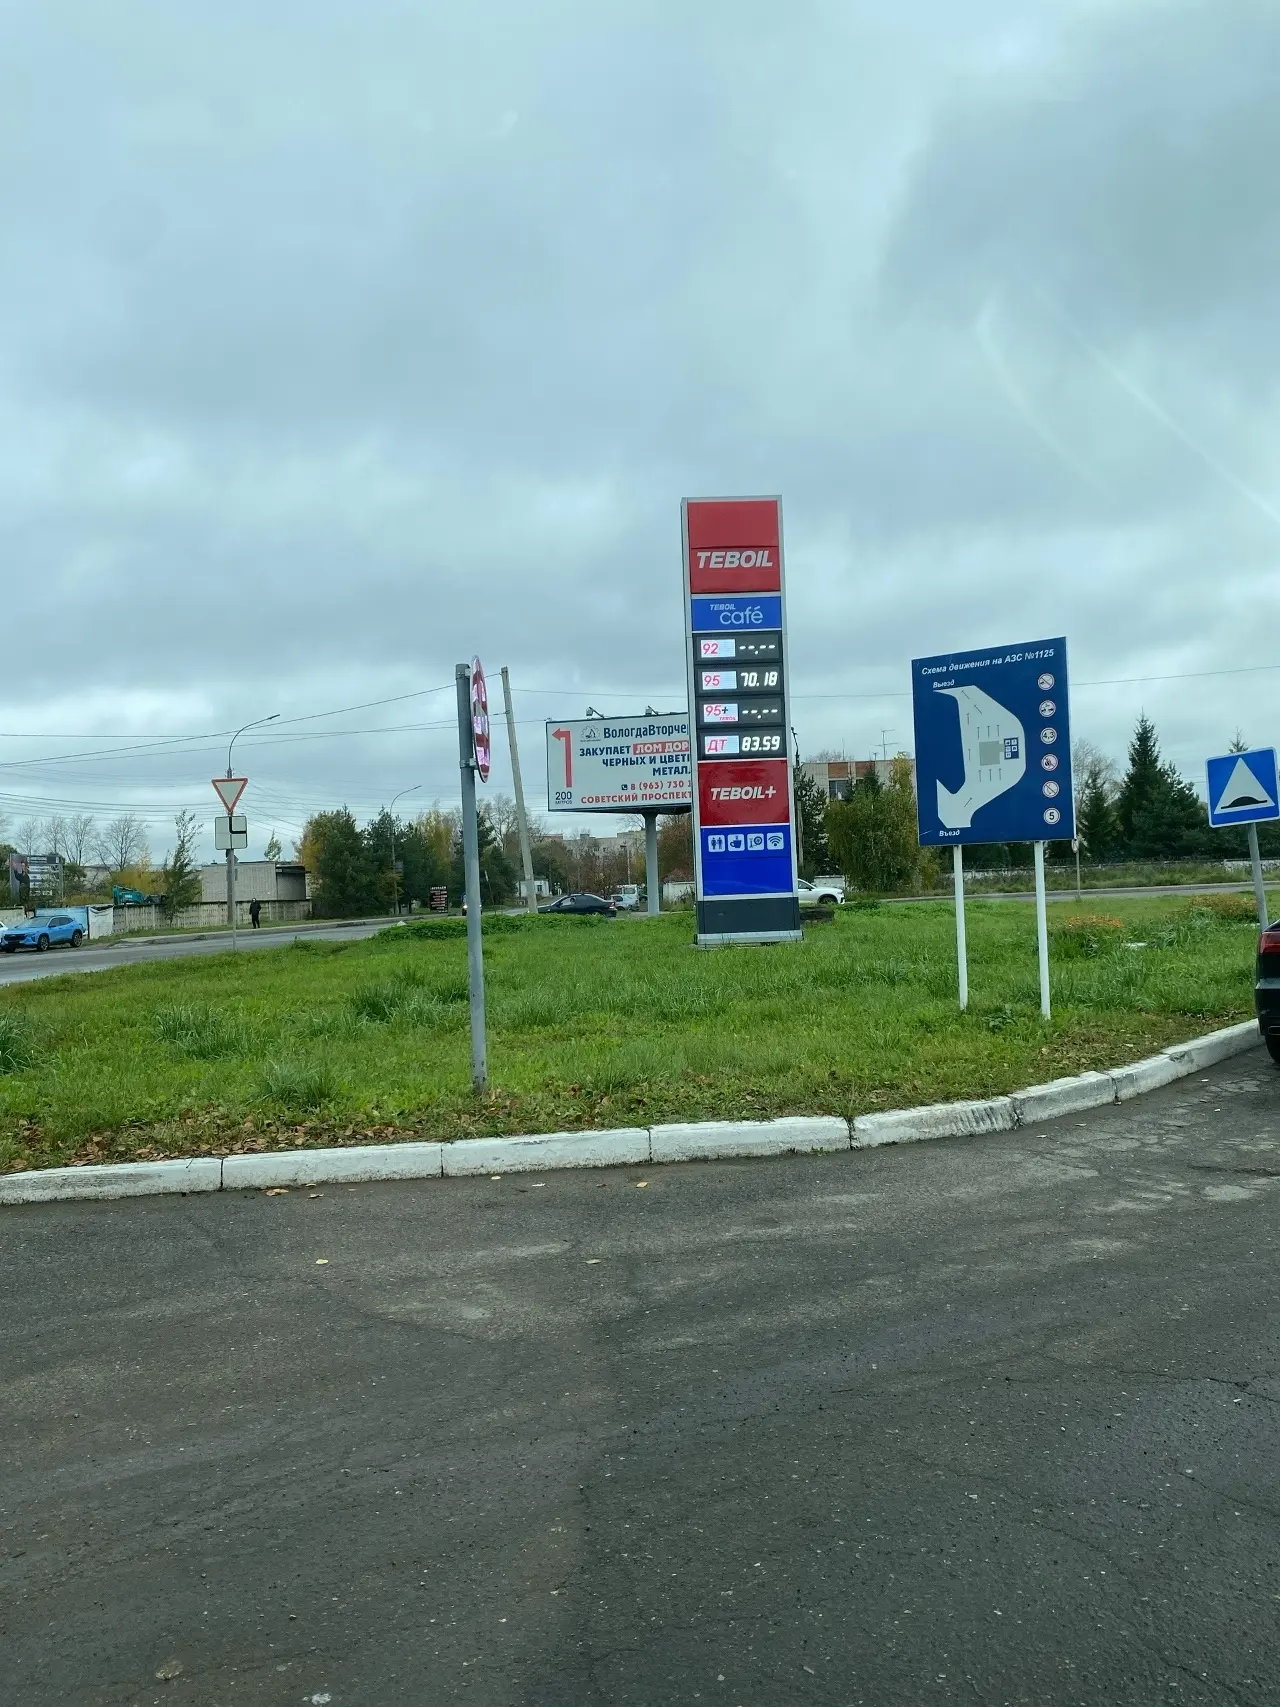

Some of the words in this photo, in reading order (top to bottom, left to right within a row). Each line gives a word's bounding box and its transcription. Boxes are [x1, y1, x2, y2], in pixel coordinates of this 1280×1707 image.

[697, 550, 774, 569] TEBOIL
[709, 603, 736, 611] TEBOIL
[719, 605, 764, 625] café
[702, 643, 719, 655] 92
[921, 667, 947, 676] Схема
[948, 659, 990, 671] движения
[1004, 653, 1023, 664] АЗС
[1024, 648, 1055, 660] №1125
[703, 674, 720, 687] 95
[740, 671, 778, 687] 70.18
[705, 705, 728, 716] 95+
[603, 723, 689, 739] ВологдаВторче
[579, 745, 631, 757] ЗАКУПАЕТ
[635, 743, 662, 754] ЛОМ
[707, 739, 727, 752] ДТ
[741, 735, 780, 751] 83.59
[602, 756, 646, 767] ЧЕРНЫХ
[649, 756, 656, 765] И
[652, 766, 691, 776] МЕТАЛ
[555, 791, 573, 801] 200
[581, 793, 638, 804] СОВЕТСКИЙ
[710, 785, 777, 801] TEBOIL+
[1048, 811, 1055, 821] 5
